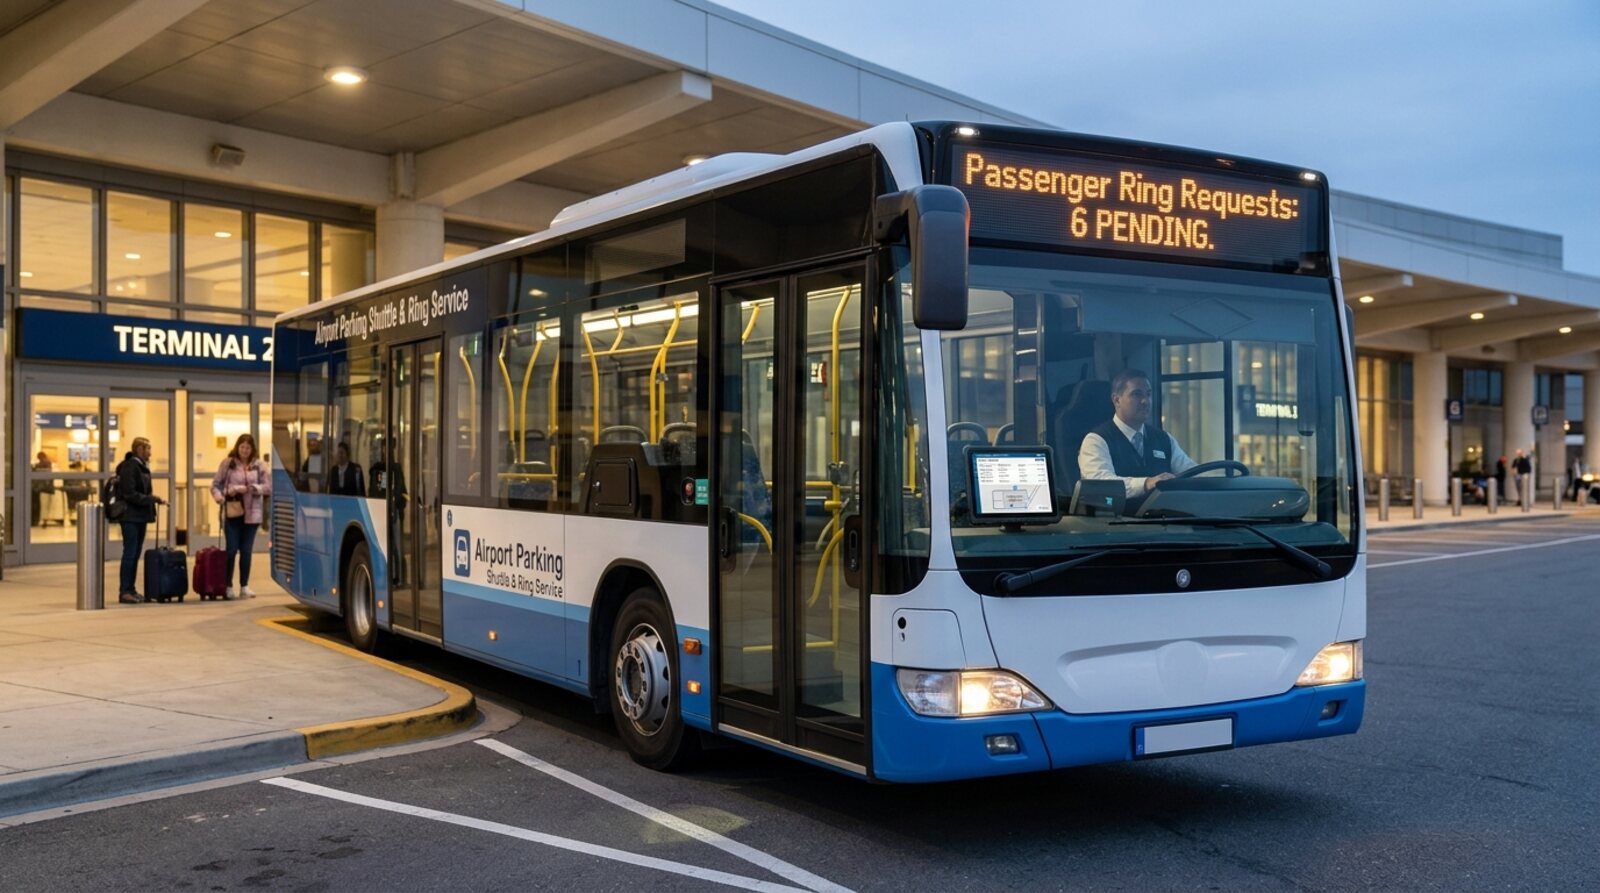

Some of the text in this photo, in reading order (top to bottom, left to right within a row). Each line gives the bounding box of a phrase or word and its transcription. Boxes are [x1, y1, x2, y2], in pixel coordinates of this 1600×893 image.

[965, 152, 1300, 220] Passenger Ring Requests:
[1069, 208, 1216, 250] 6 PENDING.
[399, 298, 406, 326] &
[431, 284, 469, 318] Service
[113, 324, 274, 362] TERMINAL 2
[475, 538, 562, 580] Airport Parking
[517, 575, 534, 597] Ring
[536, 580, 563, 598] Service
